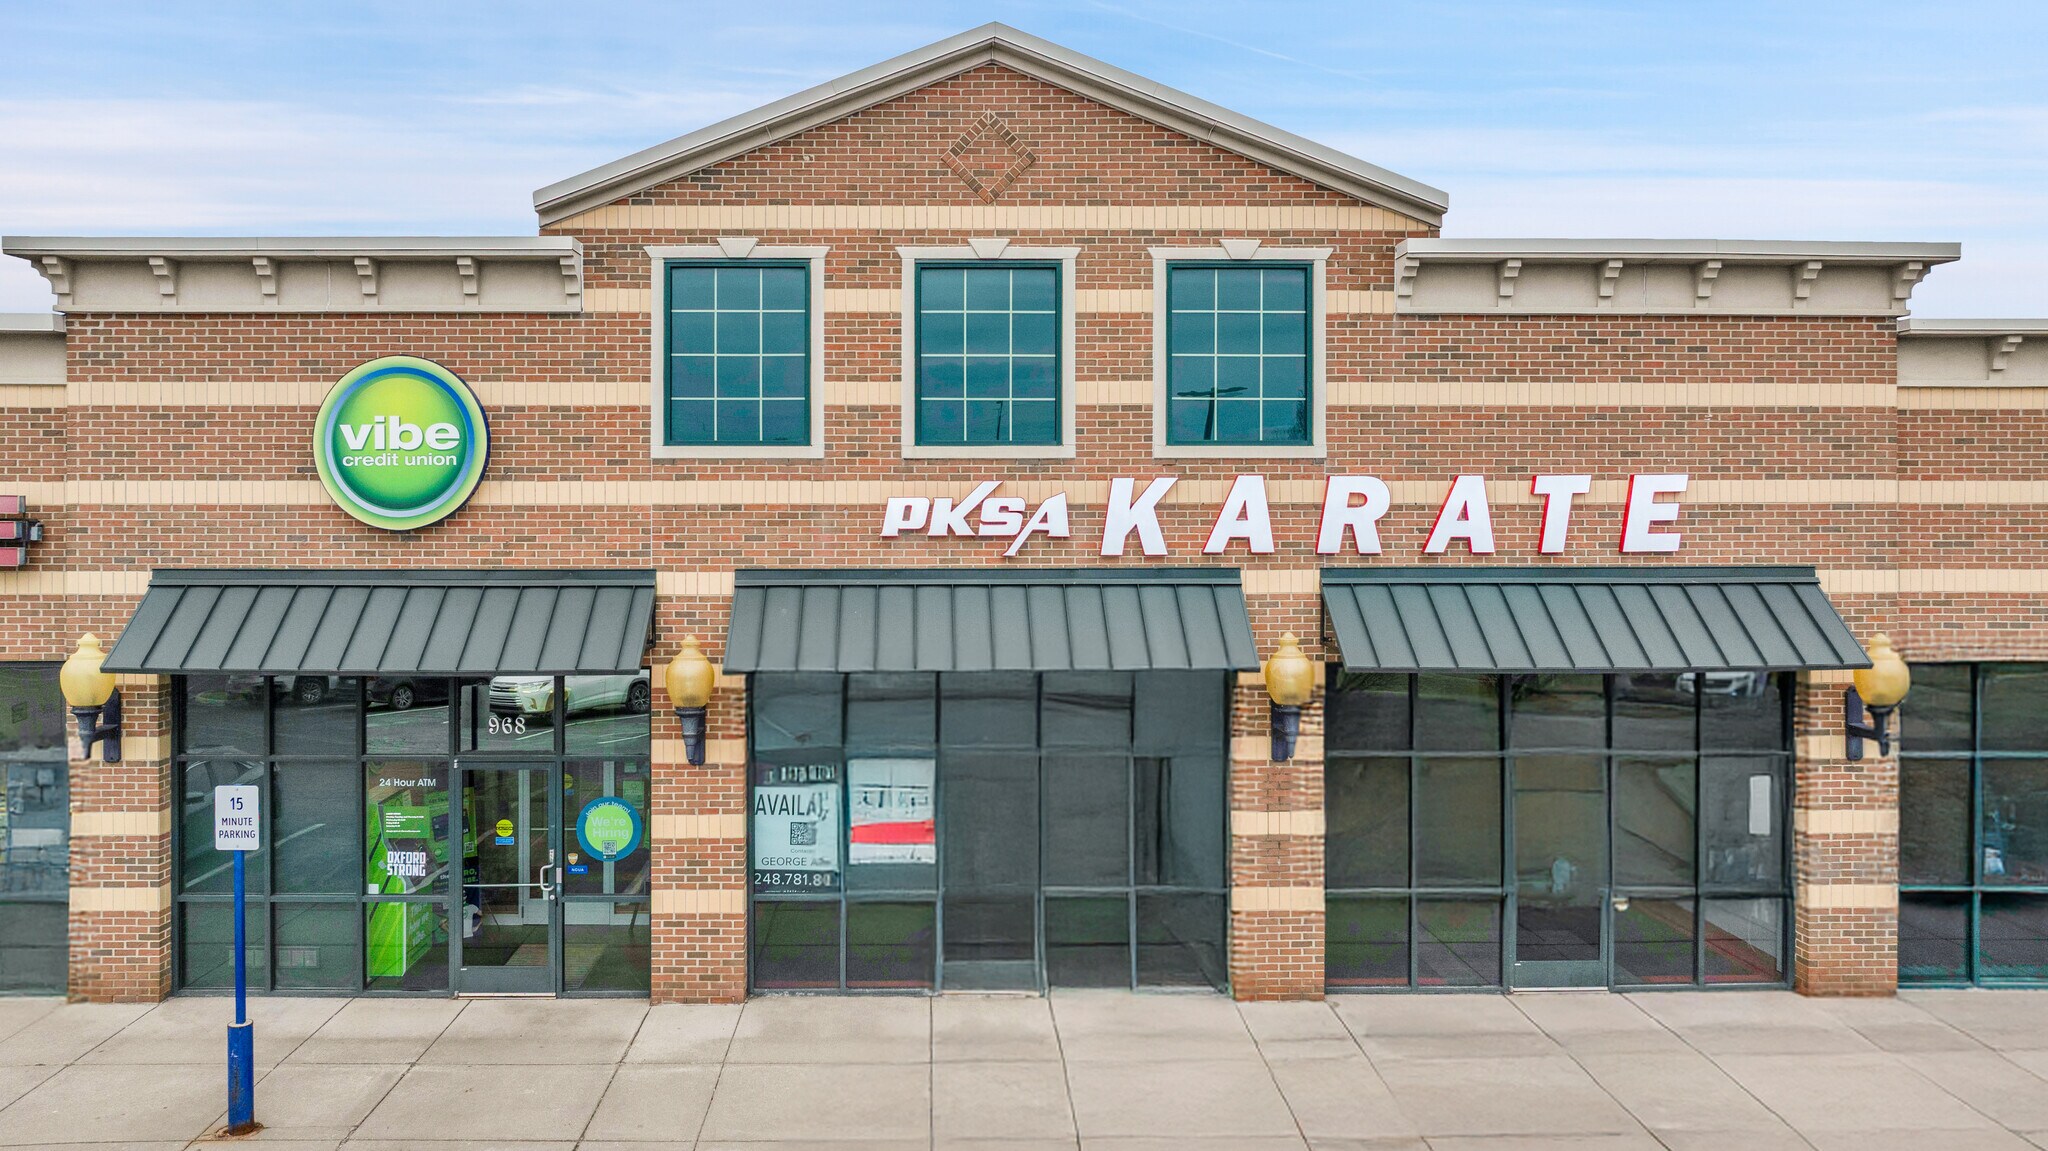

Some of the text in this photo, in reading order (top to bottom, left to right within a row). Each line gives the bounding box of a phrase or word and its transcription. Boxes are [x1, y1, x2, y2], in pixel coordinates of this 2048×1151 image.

[339, 416, 460, 450] vibe
[342, 452, 457, 466] credit union
[879, 473, 1689, 556] PKSA KARATE
[488, 717, 526, 735] 968
[379, 778, 437, 787] 24 Hour ATM
[230, 797, 243, 810] 15
[586, 805, 598, 818] Join
[221, 817, 252, 826] MINUTE
[591, 817, 626, 827] We're
[218, 829, 256, 839] PARKING
[592, 828, 629, 840] Hiring
[387, 851, 427, 863] OXFORD
[761, 857, 807, 866] GEORGE
[386, 863, 426, 877] STRONG
